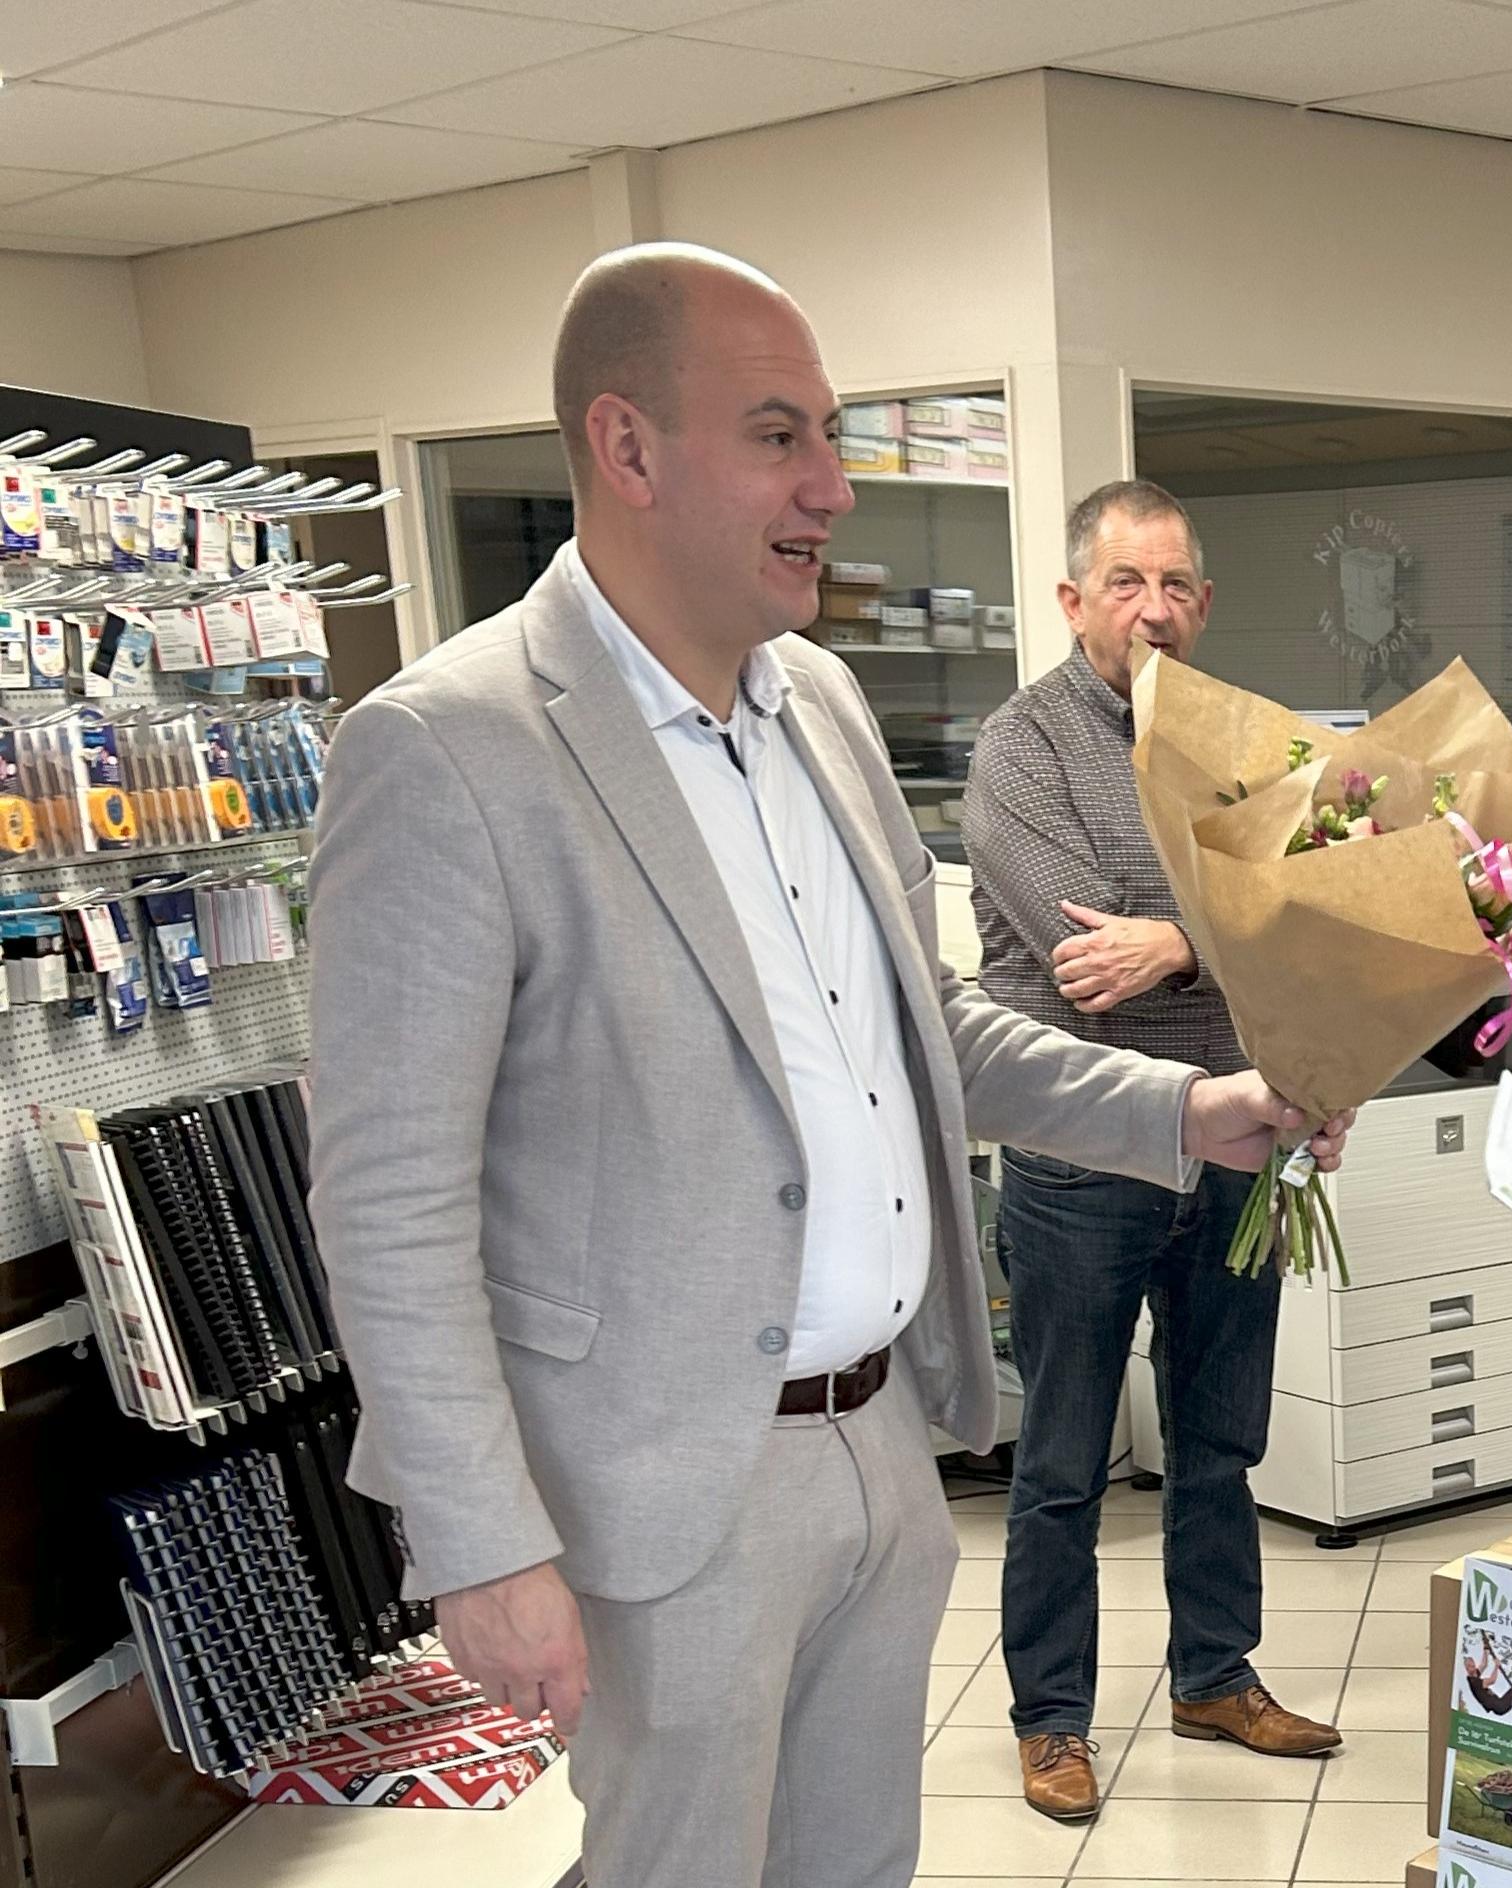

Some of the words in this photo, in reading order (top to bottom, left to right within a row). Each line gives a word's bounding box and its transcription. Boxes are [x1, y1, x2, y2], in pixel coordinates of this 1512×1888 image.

[1313, 525, 1346, 566] Kip
[1350, 509, 1415, 568] Copiers
[1318, 610, 1416, 665] Westerbork
[335, 1742, 458, 1775] idem
